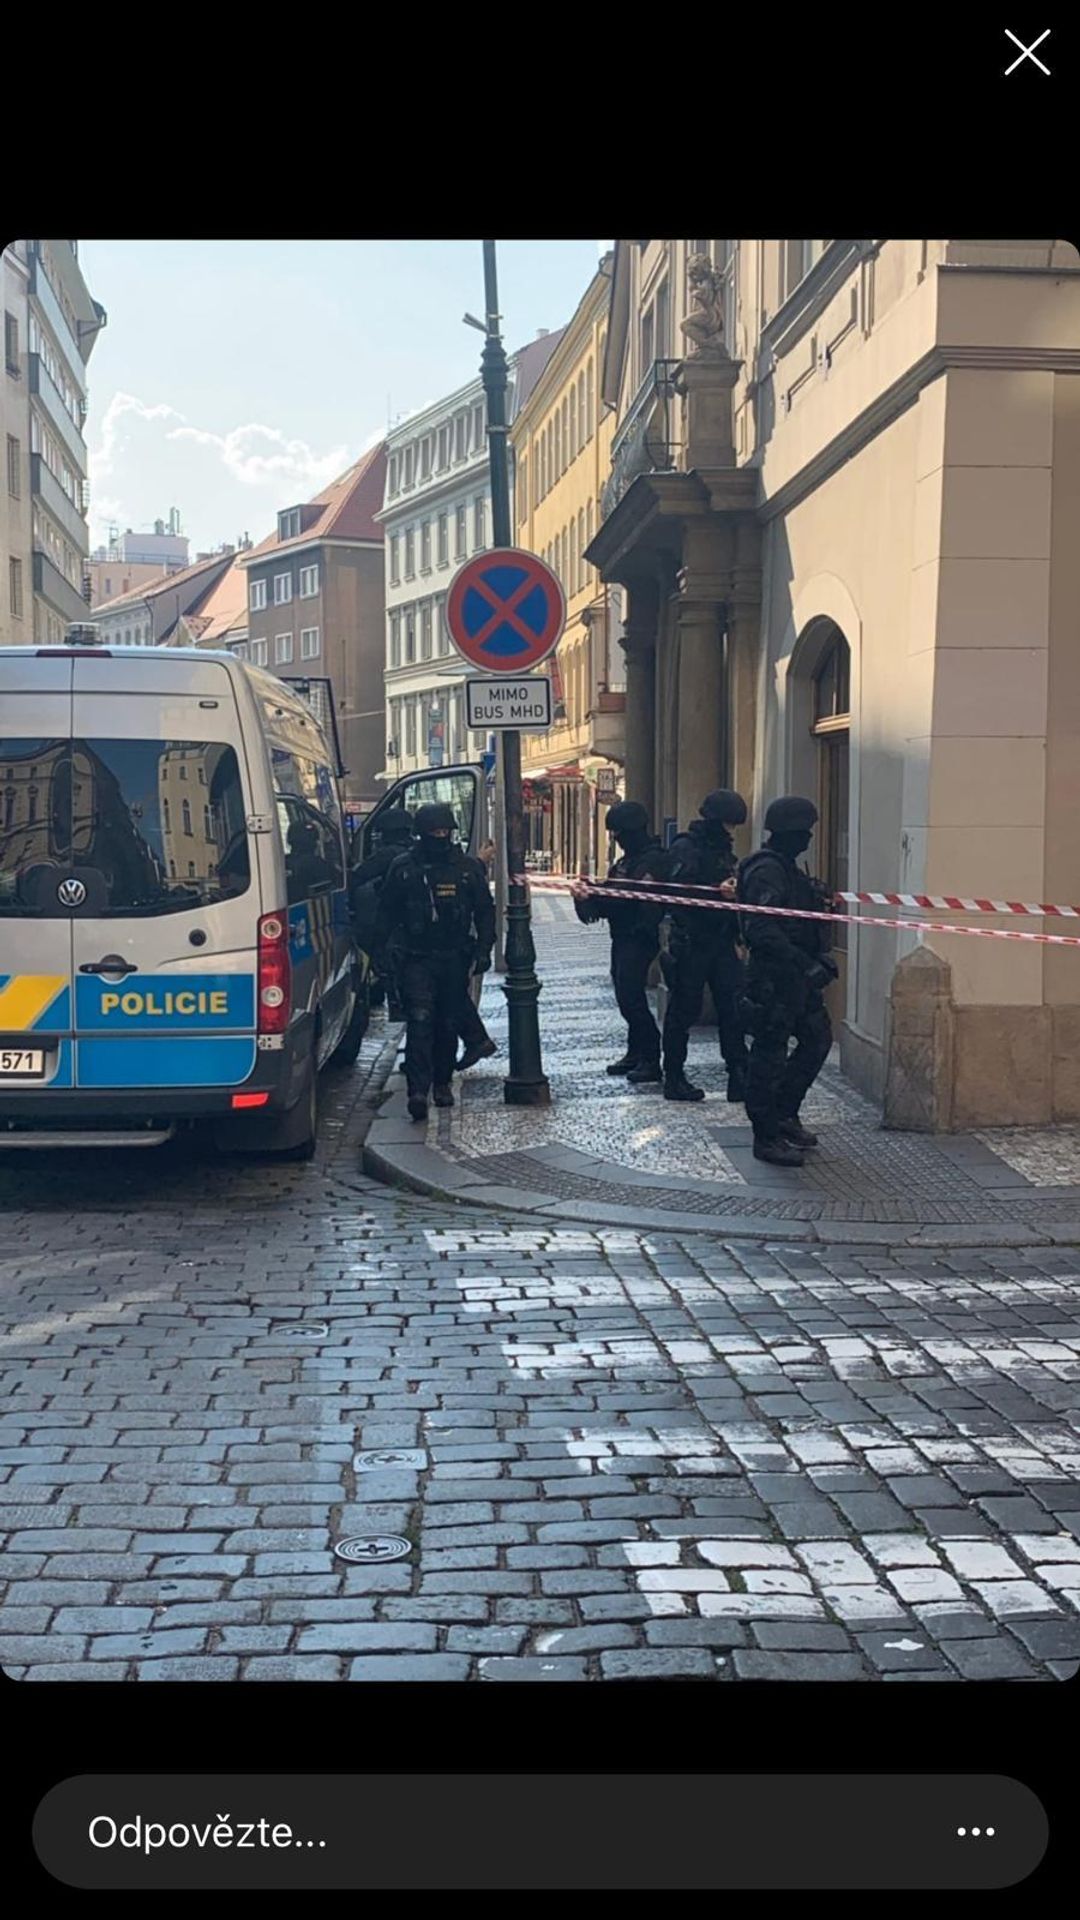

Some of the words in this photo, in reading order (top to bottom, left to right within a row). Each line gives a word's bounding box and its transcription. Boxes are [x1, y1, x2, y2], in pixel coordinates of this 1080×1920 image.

[489, 687, 528, 701] MIMO
[474, 705, 504, 719] BUS
[510, 704, 544, 718] MHD
[100, 992, 229, 1016] POLICIE
[1, 1052, 35, 1070] 571
